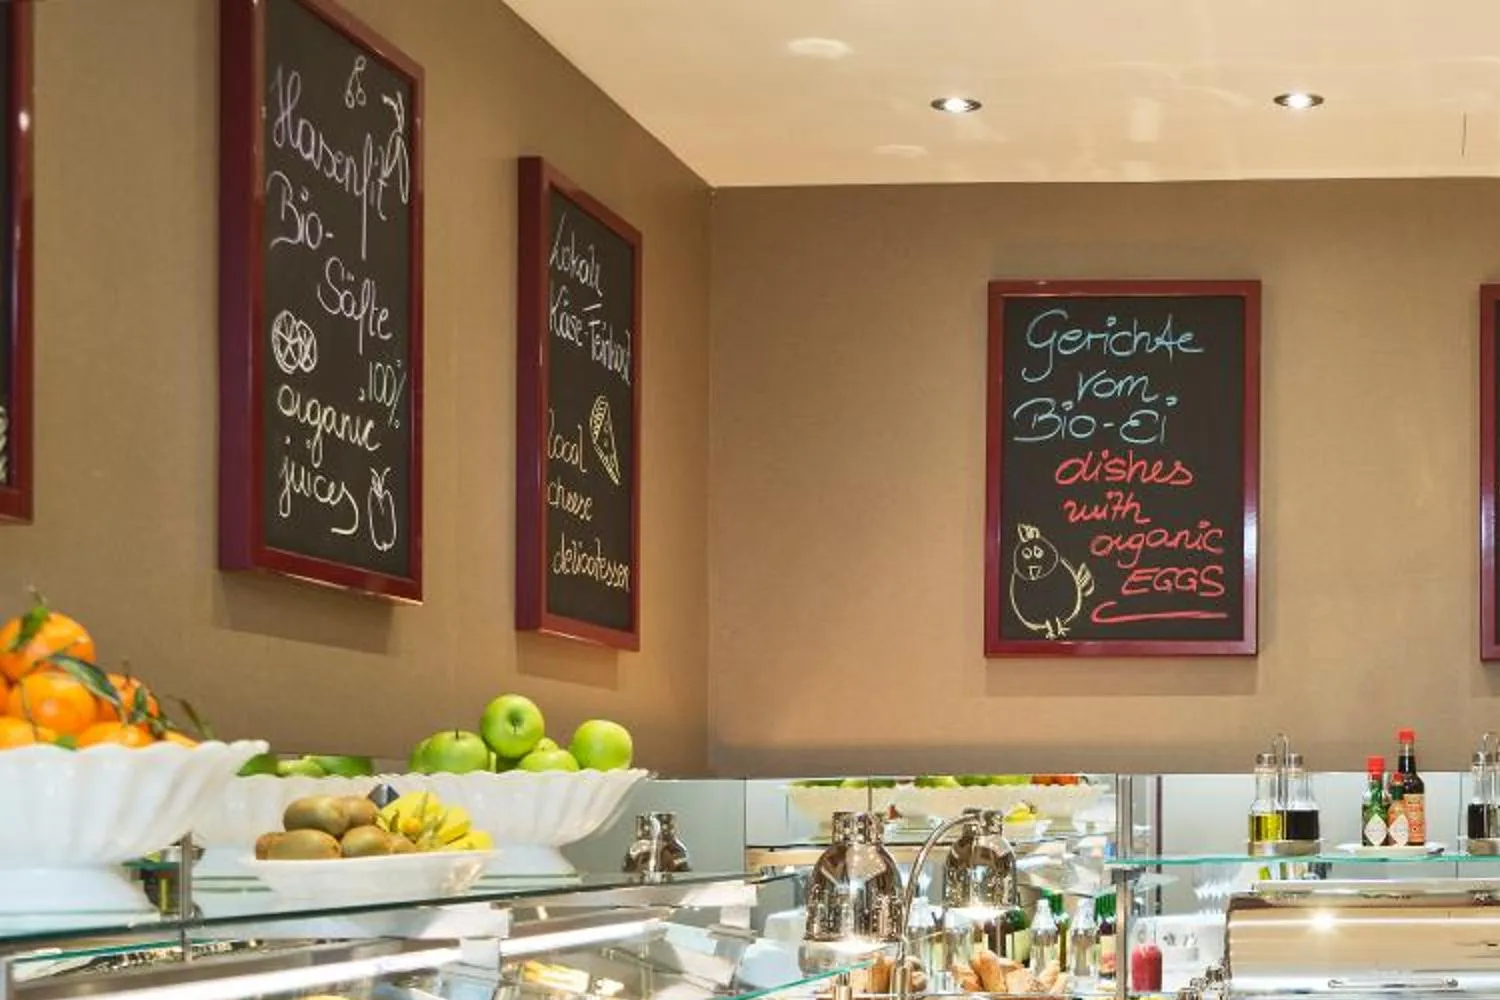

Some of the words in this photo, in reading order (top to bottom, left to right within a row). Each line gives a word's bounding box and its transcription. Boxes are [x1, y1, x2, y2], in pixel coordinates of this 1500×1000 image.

[266, 171, 335, 250] Bio-
[317, 256, 393, 355] Säfte
[1021, 309, 1204, 382] Gerichte
[277, 385, 382, 467] organic
[548, 408, 587, 473] local
[279, 436, 359, 534] juices
[548, 475, 592, 521] cheese
[1055, 450, 1194, 486] dishes
[1063, 490, 1151, 524] with
[553, 532, 630, 593] delicatessen
[1090, 520, 1224, 569] organic
[1121, 565, 1225, 597] EGGS
